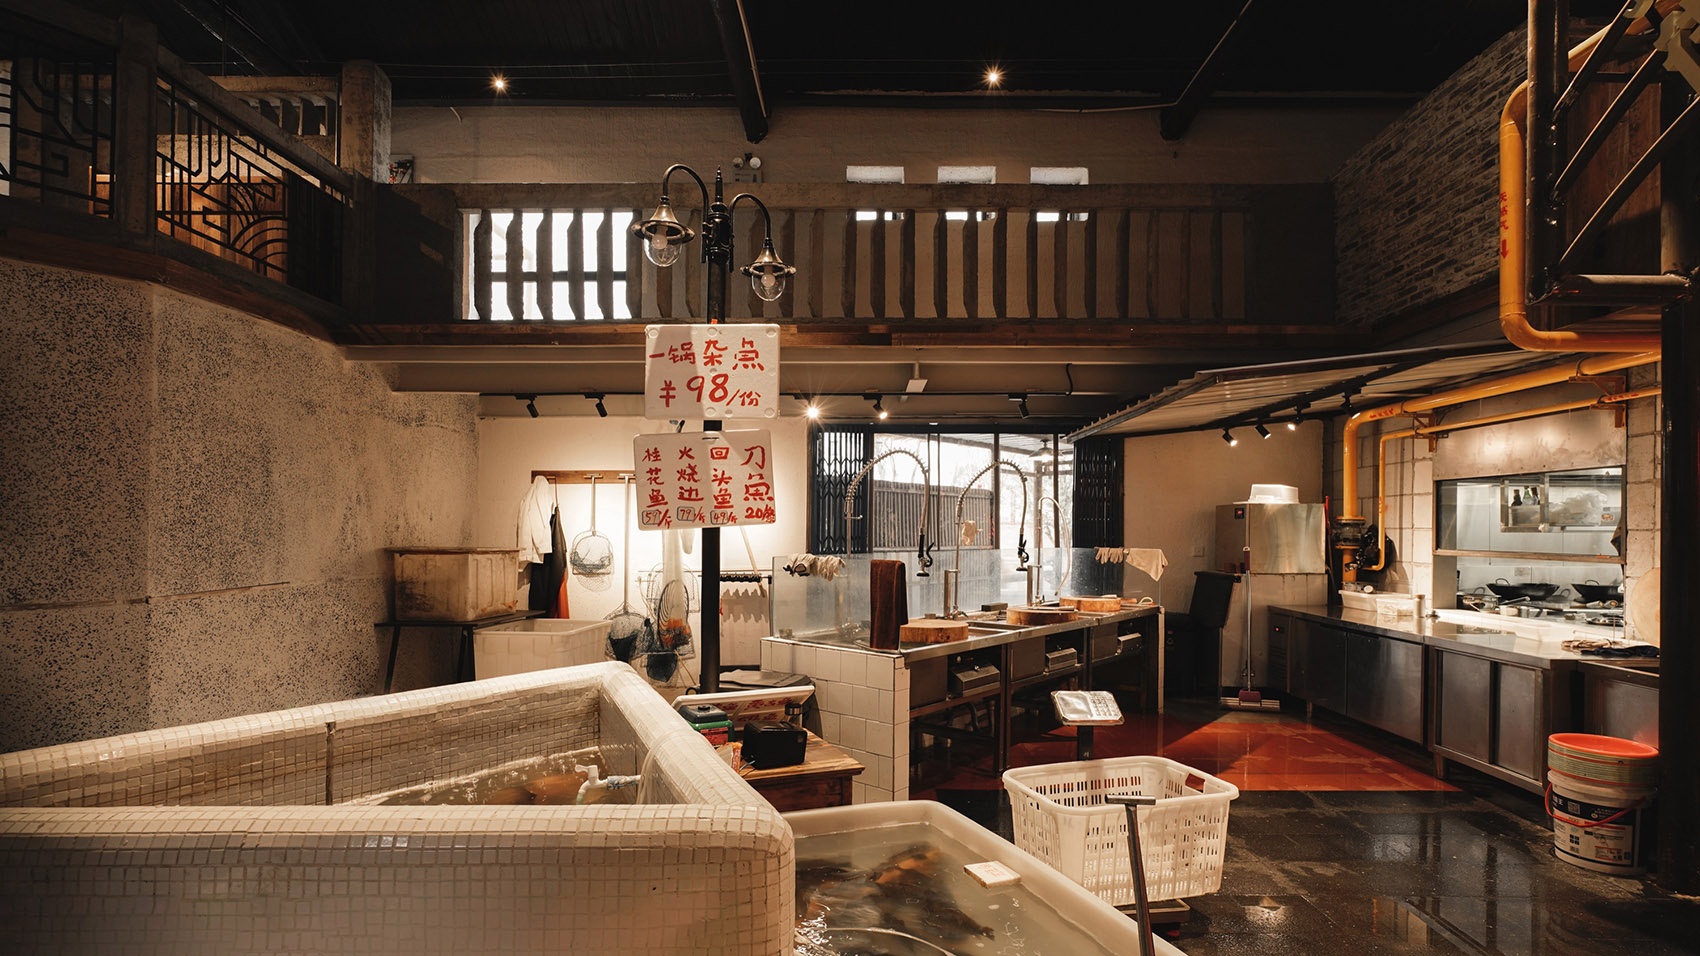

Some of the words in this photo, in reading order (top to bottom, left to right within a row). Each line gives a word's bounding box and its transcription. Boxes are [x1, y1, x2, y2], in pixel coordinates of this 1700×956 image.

[642, 447, 669, 508] 桂花鱼
[710, 447, 734, 509] 回头鱼
